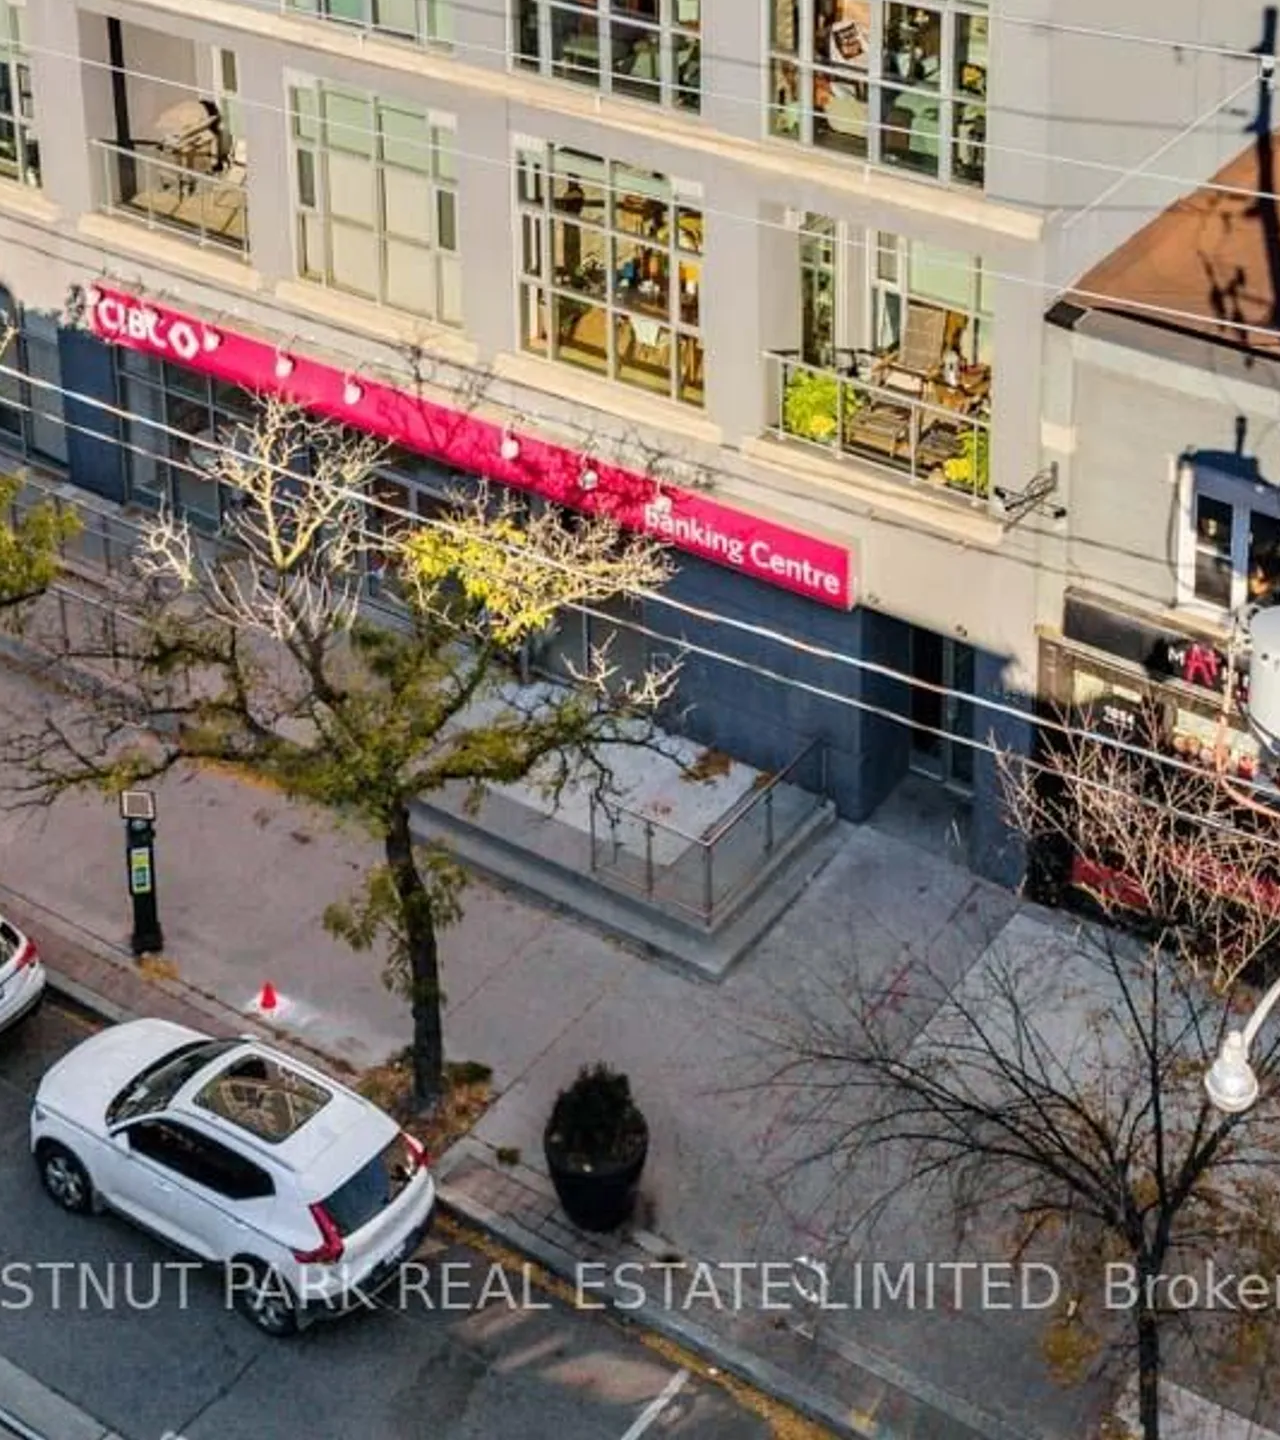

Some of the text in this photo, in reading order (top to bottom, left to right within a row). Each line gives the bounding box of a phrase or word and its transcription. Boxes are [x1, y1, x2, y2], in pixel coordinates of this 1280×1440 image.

[97, 298, 167, 348] CIBC
[645, 503, 841, 594] Banking Centre
